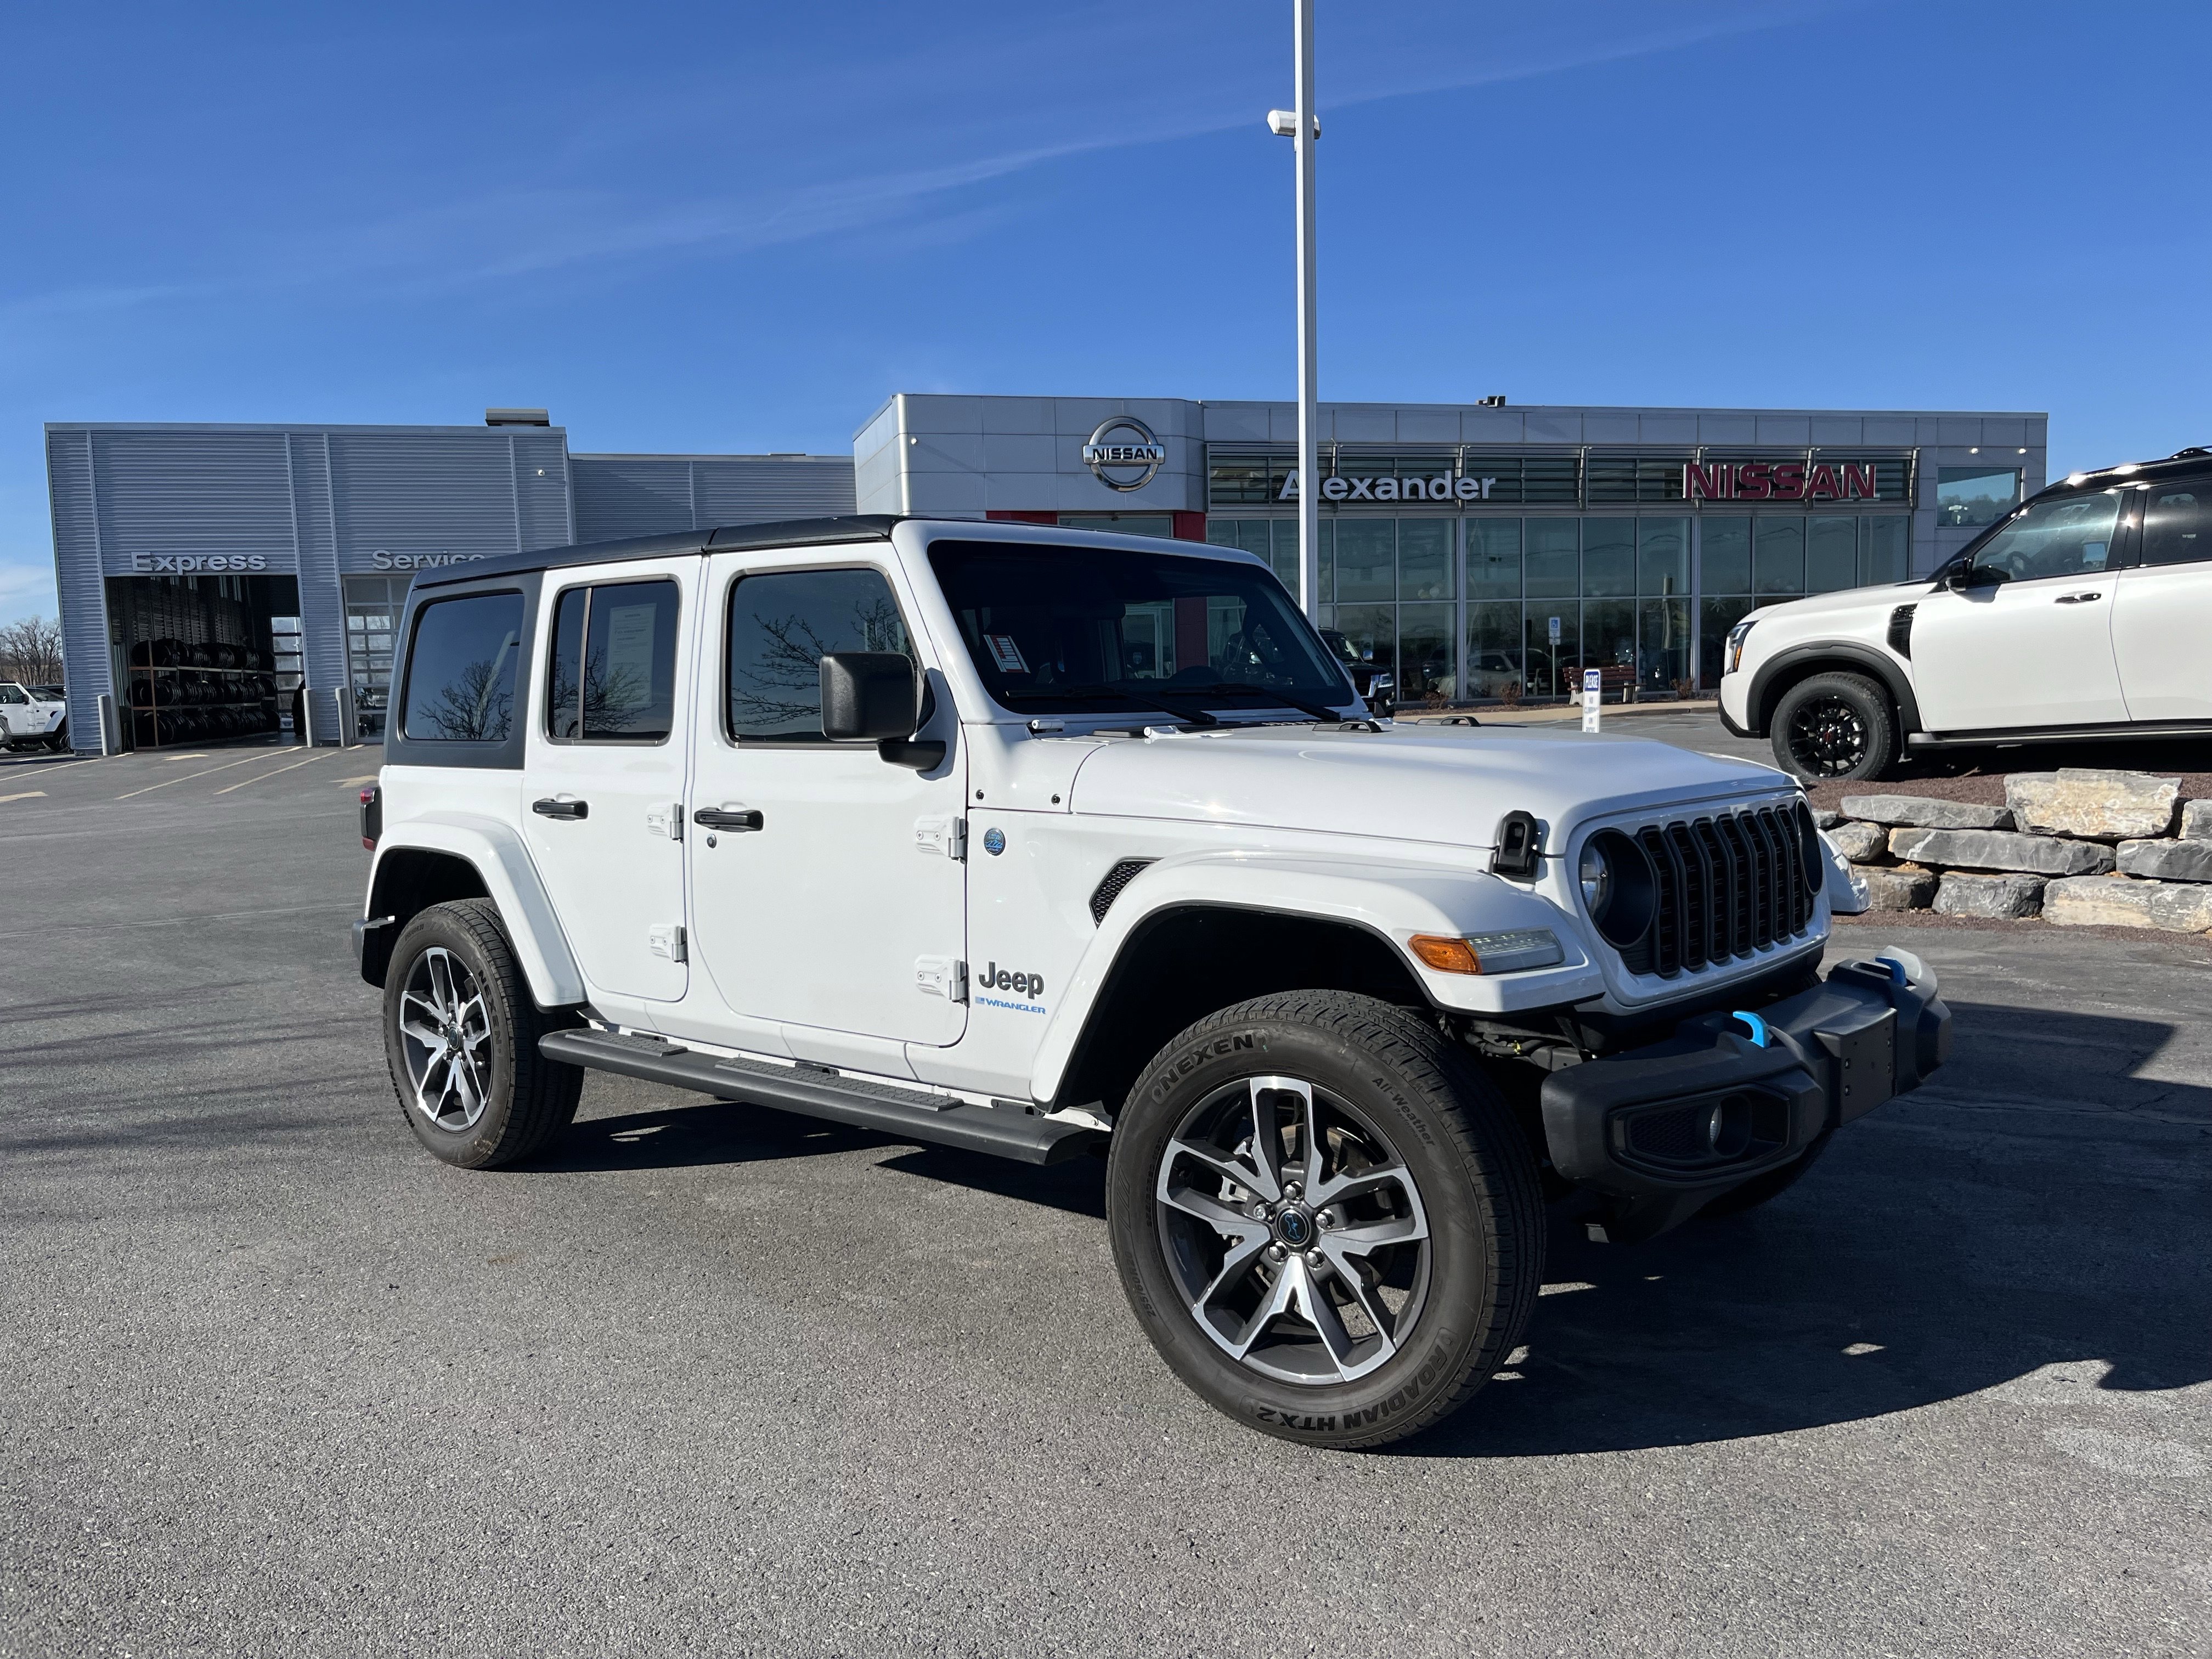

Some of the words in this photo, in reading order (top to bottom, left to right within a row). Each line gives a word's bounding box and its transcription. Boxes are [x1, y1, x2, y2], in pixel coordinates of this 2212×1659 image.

[1093, 448, 1157, 460] NISSAN
[1683, 464, 1877, 499] NISSAN
[131, 551, 266, 575] Express
[1585, 675, 1598, 689] PLEASE
[979, 961, 1044, 1000] Jeep
[478, 969, 502, 1045] NEXEN
[985, 998, 1046, 1014] WRANGLER
[1160, 1034, 1254, 1091] NEXEN
[1372, 1077, 1436, 1146] All-Weather
[1343, 1344, 1448, 1427] ROADIAN
[1256, 1406, 1335, 1431] HTX2
